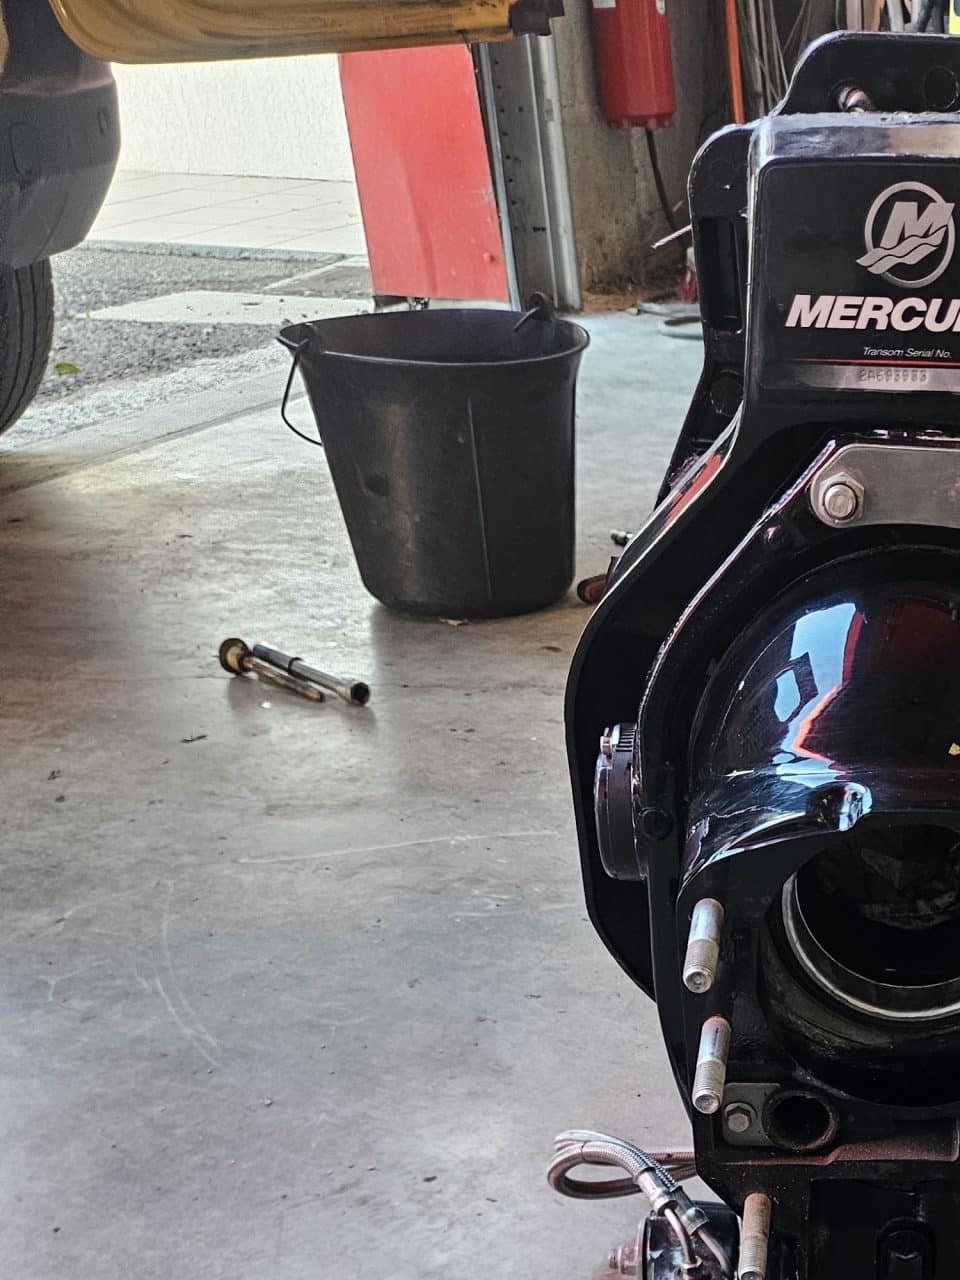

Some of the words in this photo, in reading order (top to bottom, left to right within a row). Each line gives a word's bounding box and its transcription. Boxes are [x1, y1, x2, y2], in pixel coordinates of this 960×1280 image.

[863, 346, 903, 357] Transom
[905, 347, 934, 358] Serial
[935, 349, 952, 359] No.
